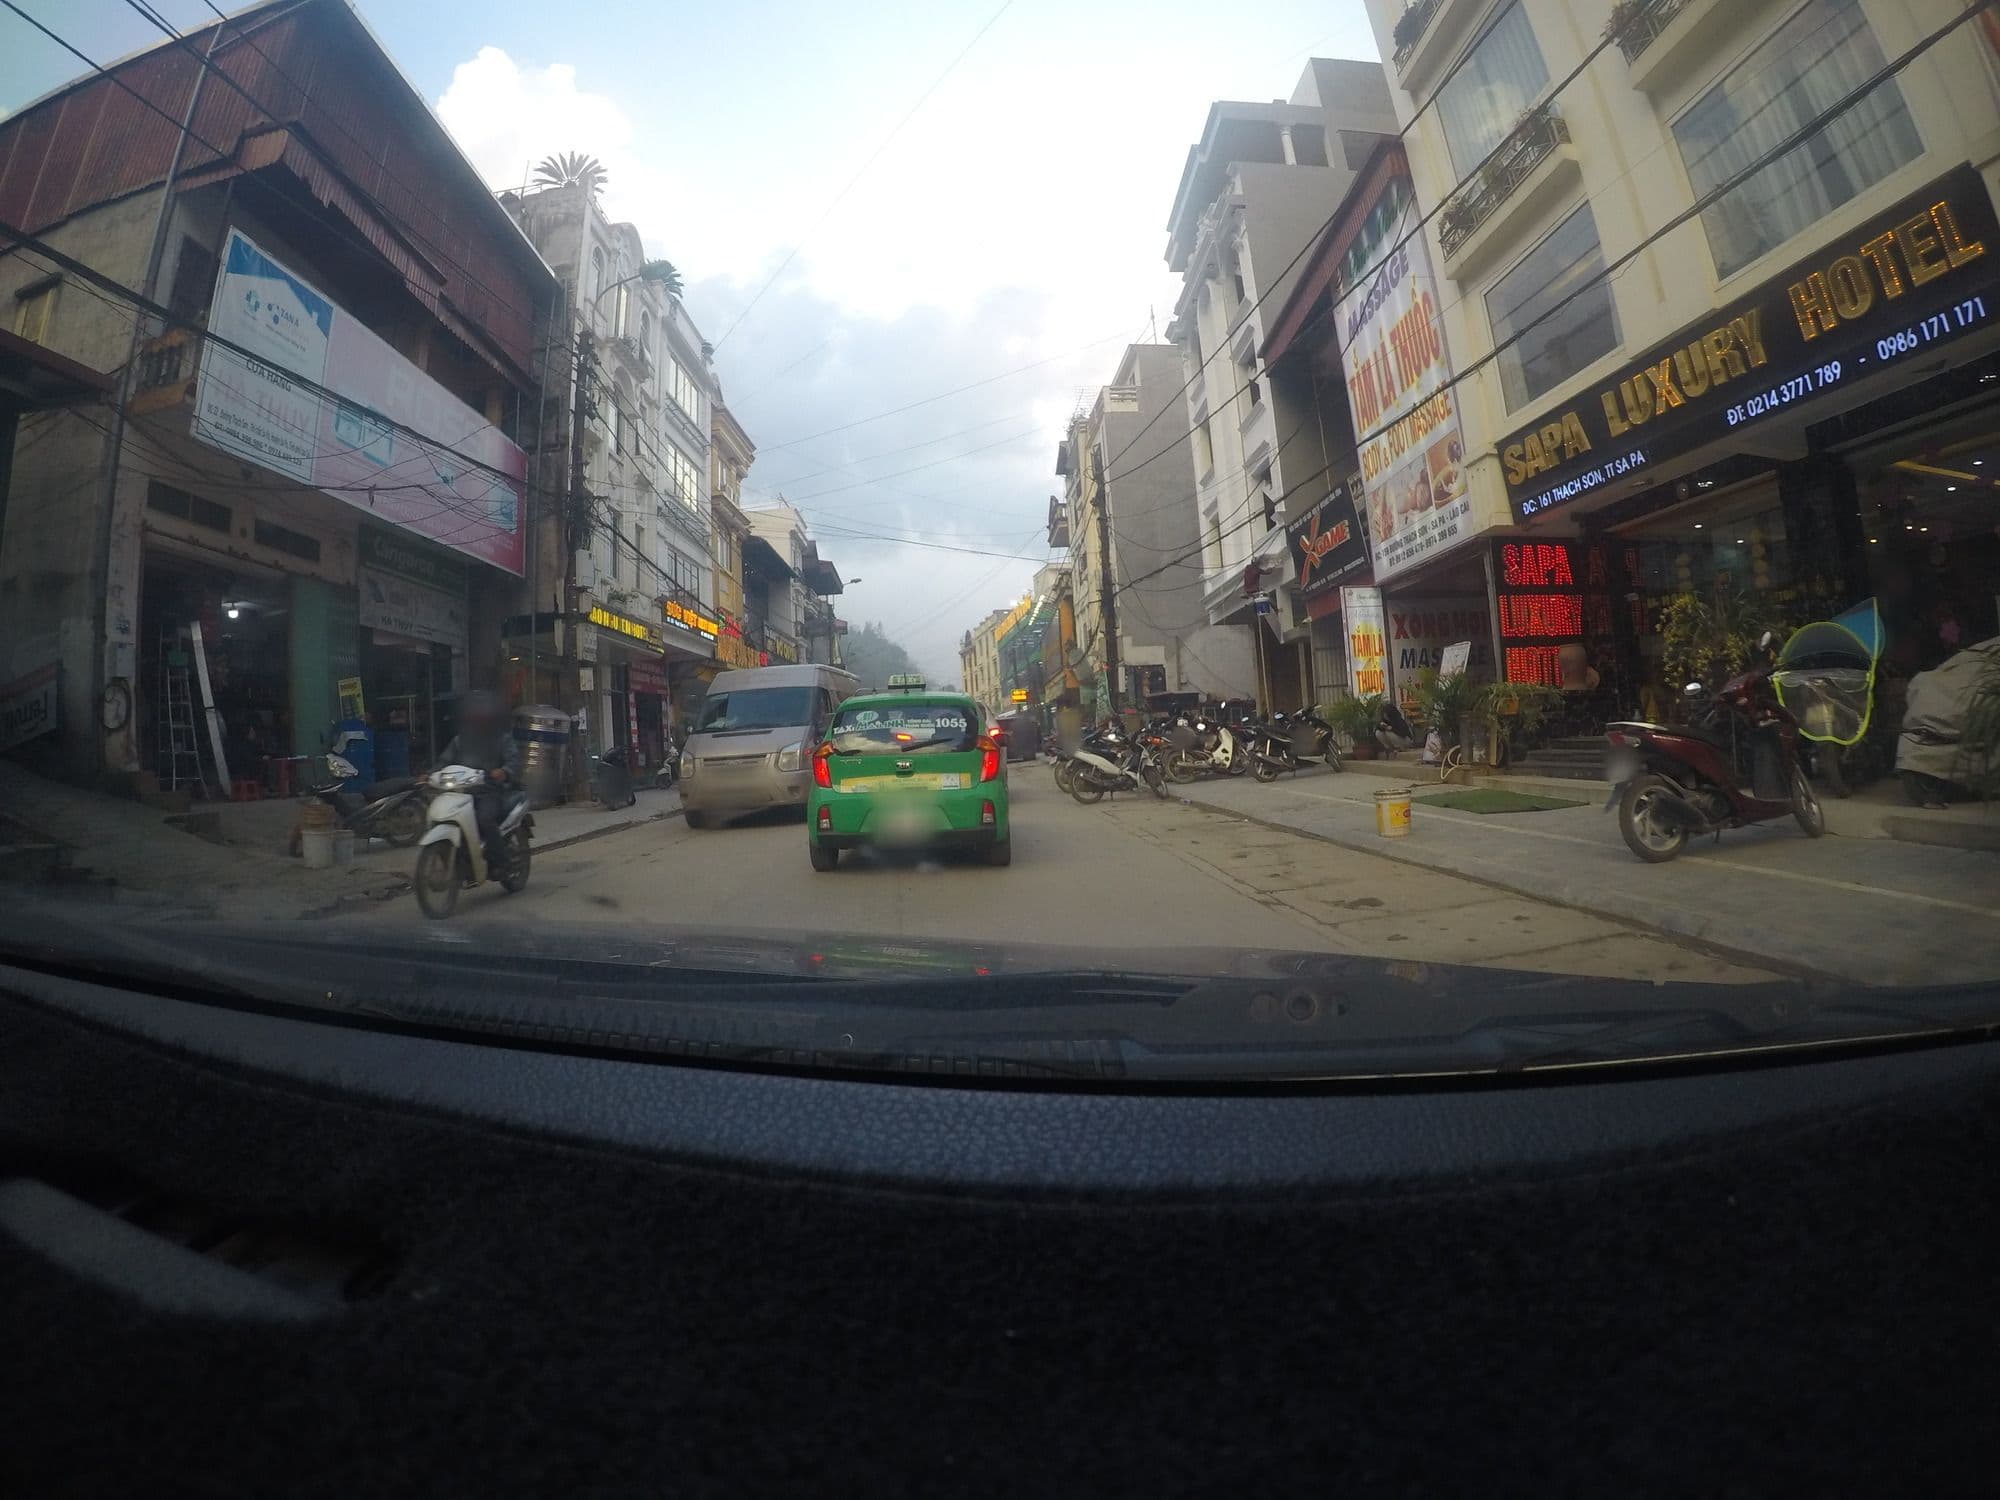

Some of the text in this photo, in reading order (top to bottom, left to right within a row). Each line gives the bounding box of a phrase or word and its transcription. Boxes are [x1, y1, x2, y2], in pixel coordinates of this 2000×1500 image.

[1347, 243, 1409, 341] MASSAGE
[1503, 200, 1986, 486] SAPA LUXURY HOTEL
[1727, 405, 1746, 427] ĐT:
[1747, 389, 1779, 418] 0214
[1780, 373, 1814, 404] 3771
[1815, 360, 1842, 388] 789
[1877, 328, 1918, 361] 0986
[1920, 313, 1951, 342] 171
[1953, 296, 1987, 327] 171
[1361, 441, 1384, 482] BODY
[1387, 421, 1410, 463] FOOT
[1409, 379, 1453, 447] MASSAGE
[1522, 500, 1538, 515] ĐC:
[1538, 492, 1553, 508] 161
[1552, 482, 1582, 501] THẠCH
[1604, 463, 1616, 480] TT
[1615, 457, 1631, 474] SA
[1630, 450, 1646, 468] PA
[1503, 543, 1573, 586] SAPA
[1498, 593, 1583, 637] LUXURY
[935, 718, 967, 729] 1055
